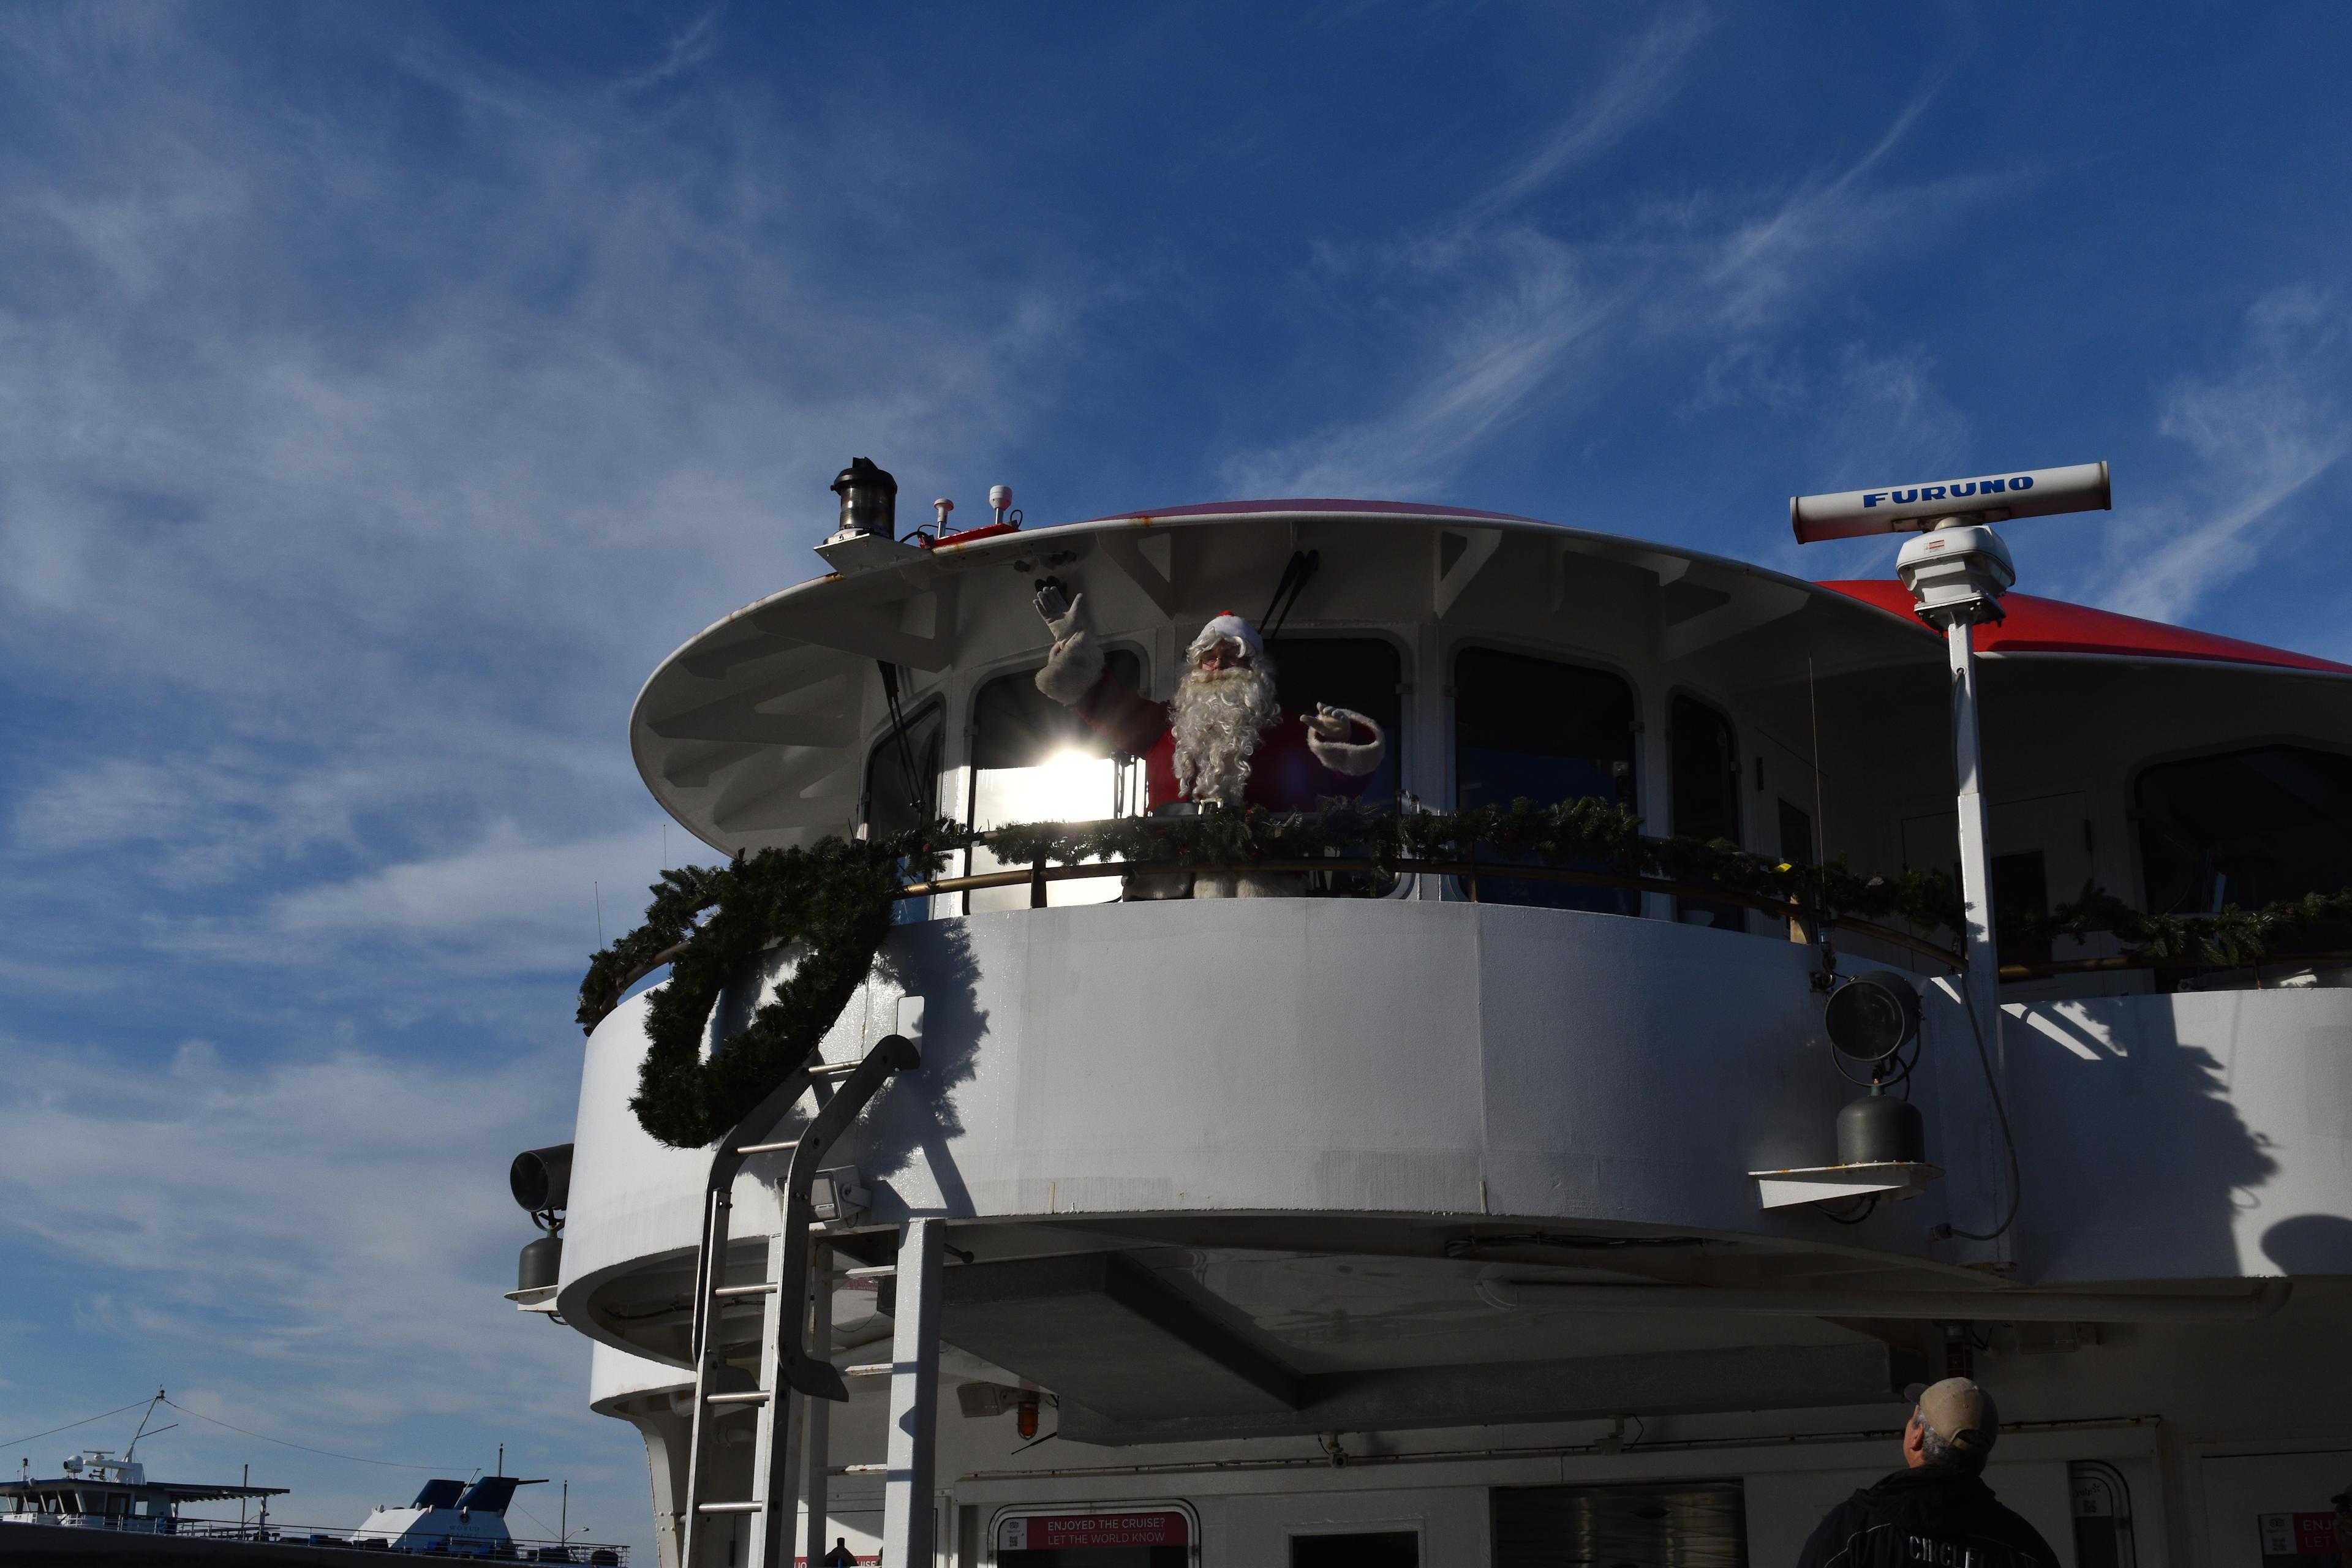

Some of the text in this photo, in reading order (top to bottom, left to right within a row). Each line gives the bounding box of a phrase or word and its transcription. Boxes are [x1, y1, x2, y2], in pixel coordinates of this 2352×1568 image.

[1863, 476, 2034, 508] FURUNO
[1048, 1517, 1166, 1531] ENJOYED THE CRUISE?
[2303, 1518, 2332, 1531] ENJ
[1048, 1532, 1166, 1545] LET THE WORLD KNOW
[2305, 1536, 2332, 1548] LET
[1907, 1535, 1980, 1568] CIRCLE
